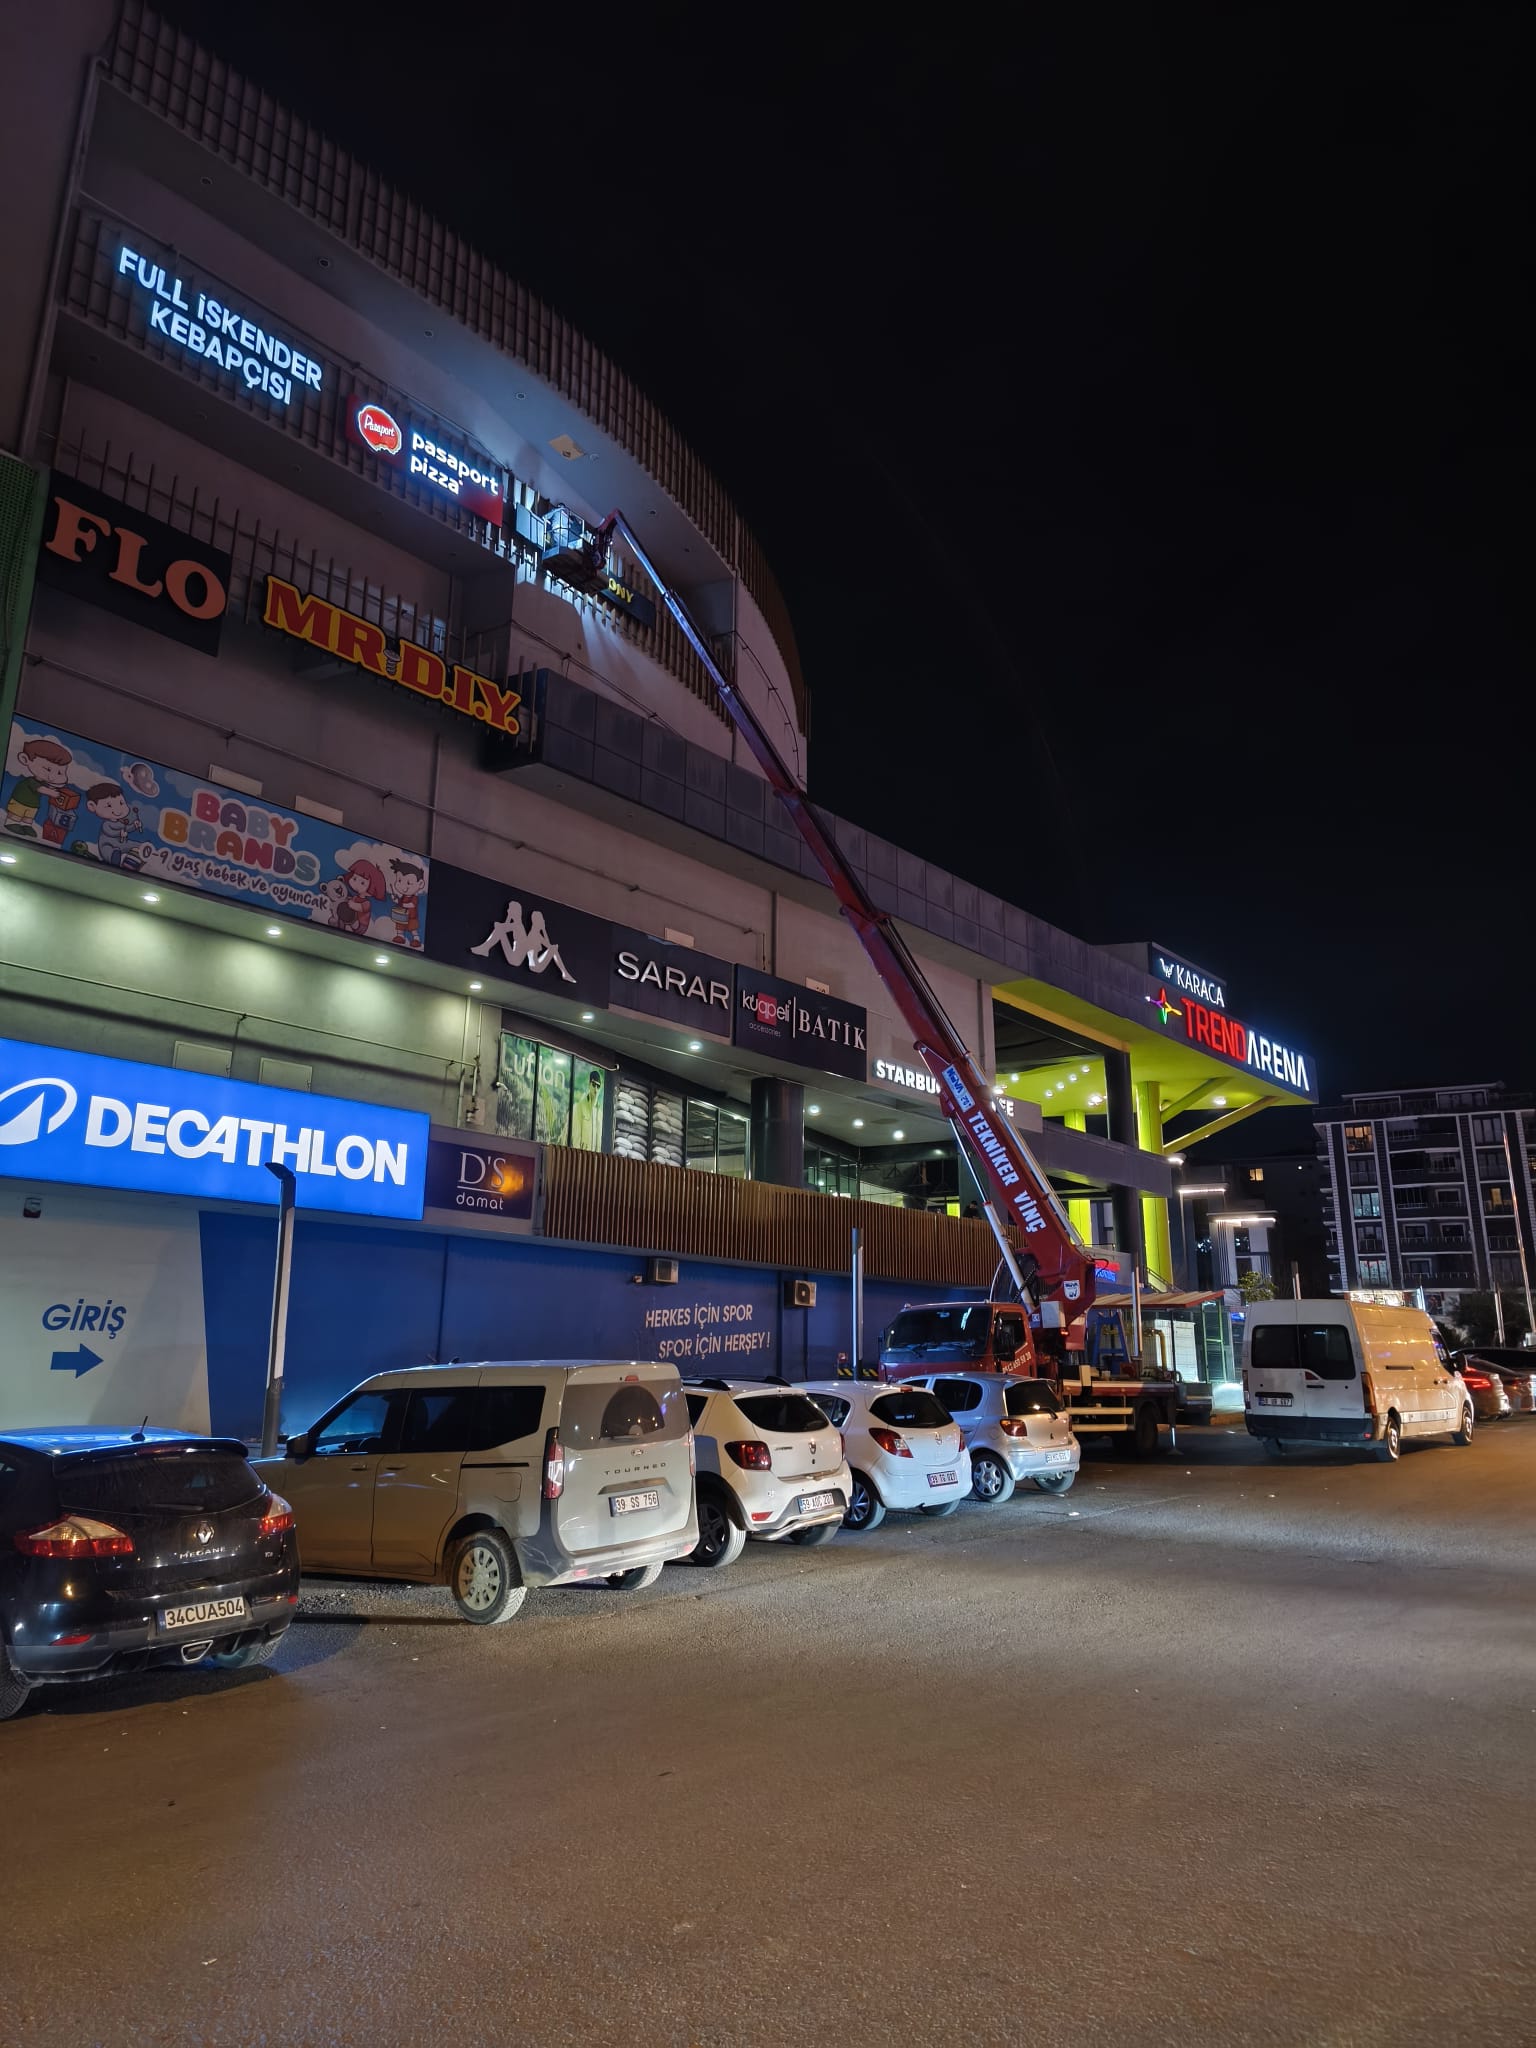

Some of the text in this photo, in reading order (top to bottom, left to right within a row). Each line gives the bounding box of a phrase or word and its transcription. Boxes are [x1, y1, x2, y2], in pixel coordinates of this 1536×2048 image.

[119, 247, 322, 391] FULL İSKENDER
[150, 301, 292, 405] KEBAPÇISI
[411, 455, 460, 495] pizza
[412, 432, 499, 496] pasaport
[46, 497, 226, 620] FLO
[195, 792, 295, 846] BABY
[142, 845, 169, 864] 0-9
[172, 855, 200, 876] yaş
[251, 878, 267, 892] ve
[163, 812, 317, 882] BRANDS
[617, 951, 730, 1010] SARAR
[1176, 964, 1225, 1008] KARACA
[798, 1008, 867, 1051] BATİK
[502, 1045, 566, 1090] Lufian
[85, 1095, 407, 1186] DECATHLON
[458, 1151, 506, 1188] D'S
[968, 1111, 1020, 1187] TEKNİKER
[1013, 1190, 1047, 1233] VİNÇ
[456, 1192, 504, 1210] damat
[42, 1298, 127, 1340] GİRİŞ
[645, 1302, 753, 1329] HERKES İÇİN SPOR
[659, 1339, 692, 1359] SPOR
[695, 1332, 721, 1359] İÇİN
[616, 1493, 658, 1511] 39 SS 756
[166, 1599, 243, 1627] 34CUA504
